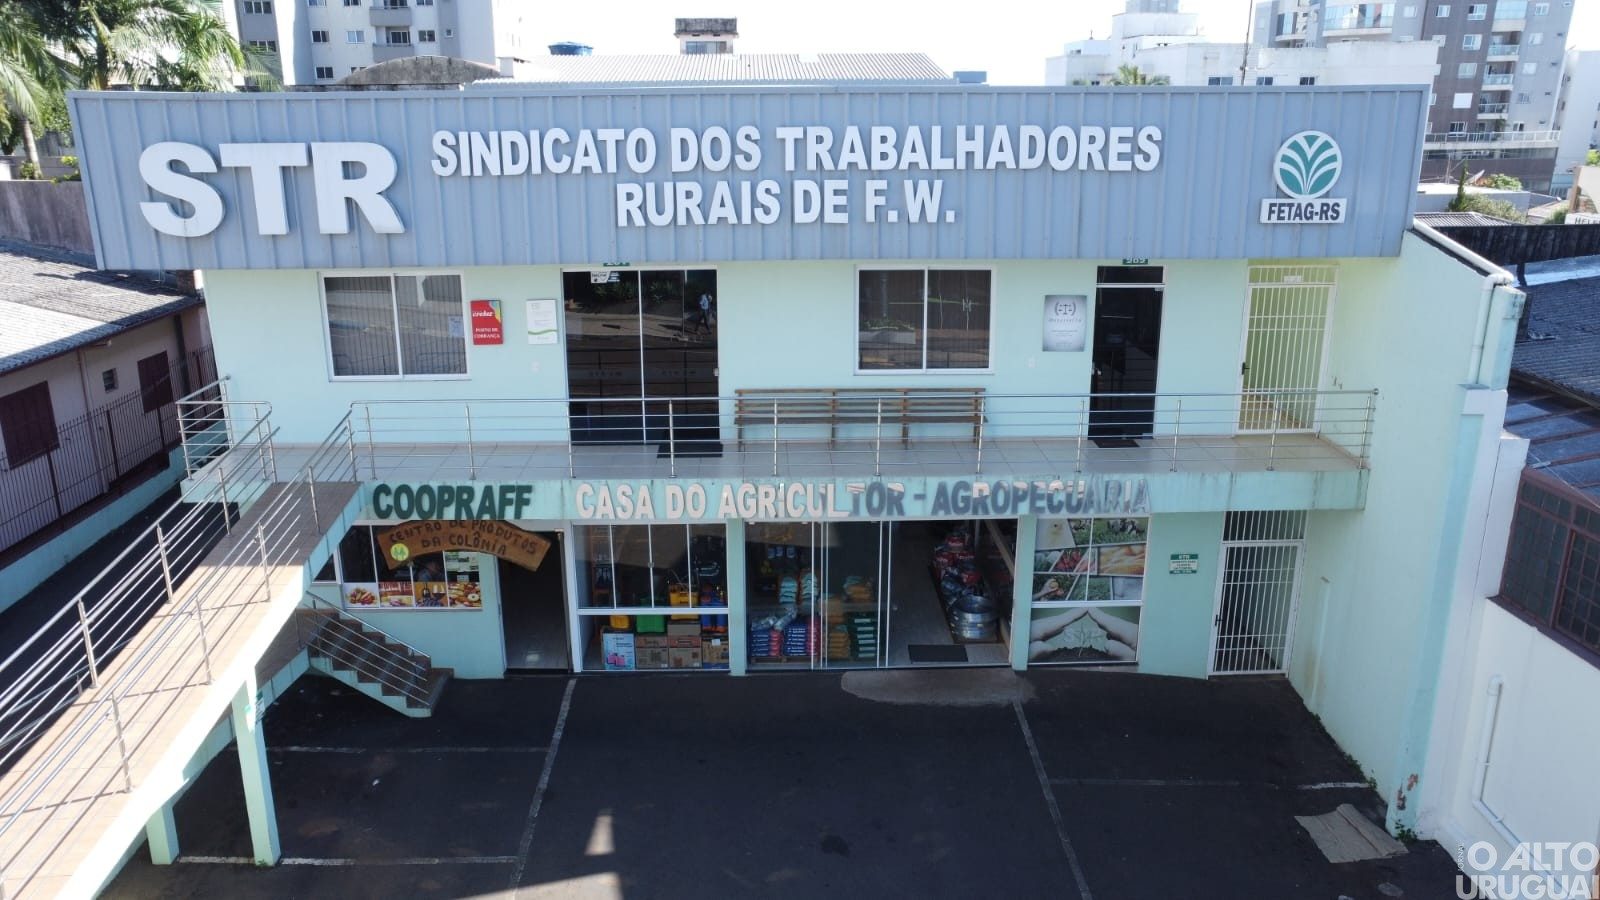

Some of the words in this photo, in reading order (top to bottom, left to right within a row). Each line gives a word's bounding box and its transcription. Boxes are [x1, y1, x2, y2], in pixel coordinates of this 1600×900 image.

[431, 127, 657, 177] SINDICATO
[671, 126, 762, 173] DOS
[776, 125, 1162, 172] TRABALHADORES
[139, 141, 405, 238] STR
[616, 179, 781, 227] RURAIS
[793, 179, 849, 224] DE
[865, 179, 956, 224] F.W.
[1267, 202, 1341, 221] FETAG-RS
[373, 483, 533, 520] COOPRAFF
[576, 483, 656, 520] CASA
[666, 483, 707, 519] DO
[718, 481, 906, 519] AGRICULTOR
[389, 521, 442, 544] CENTRO
[471, 519, 538, 555] PRODUTOS
[421, 537, 441, 548] DA
